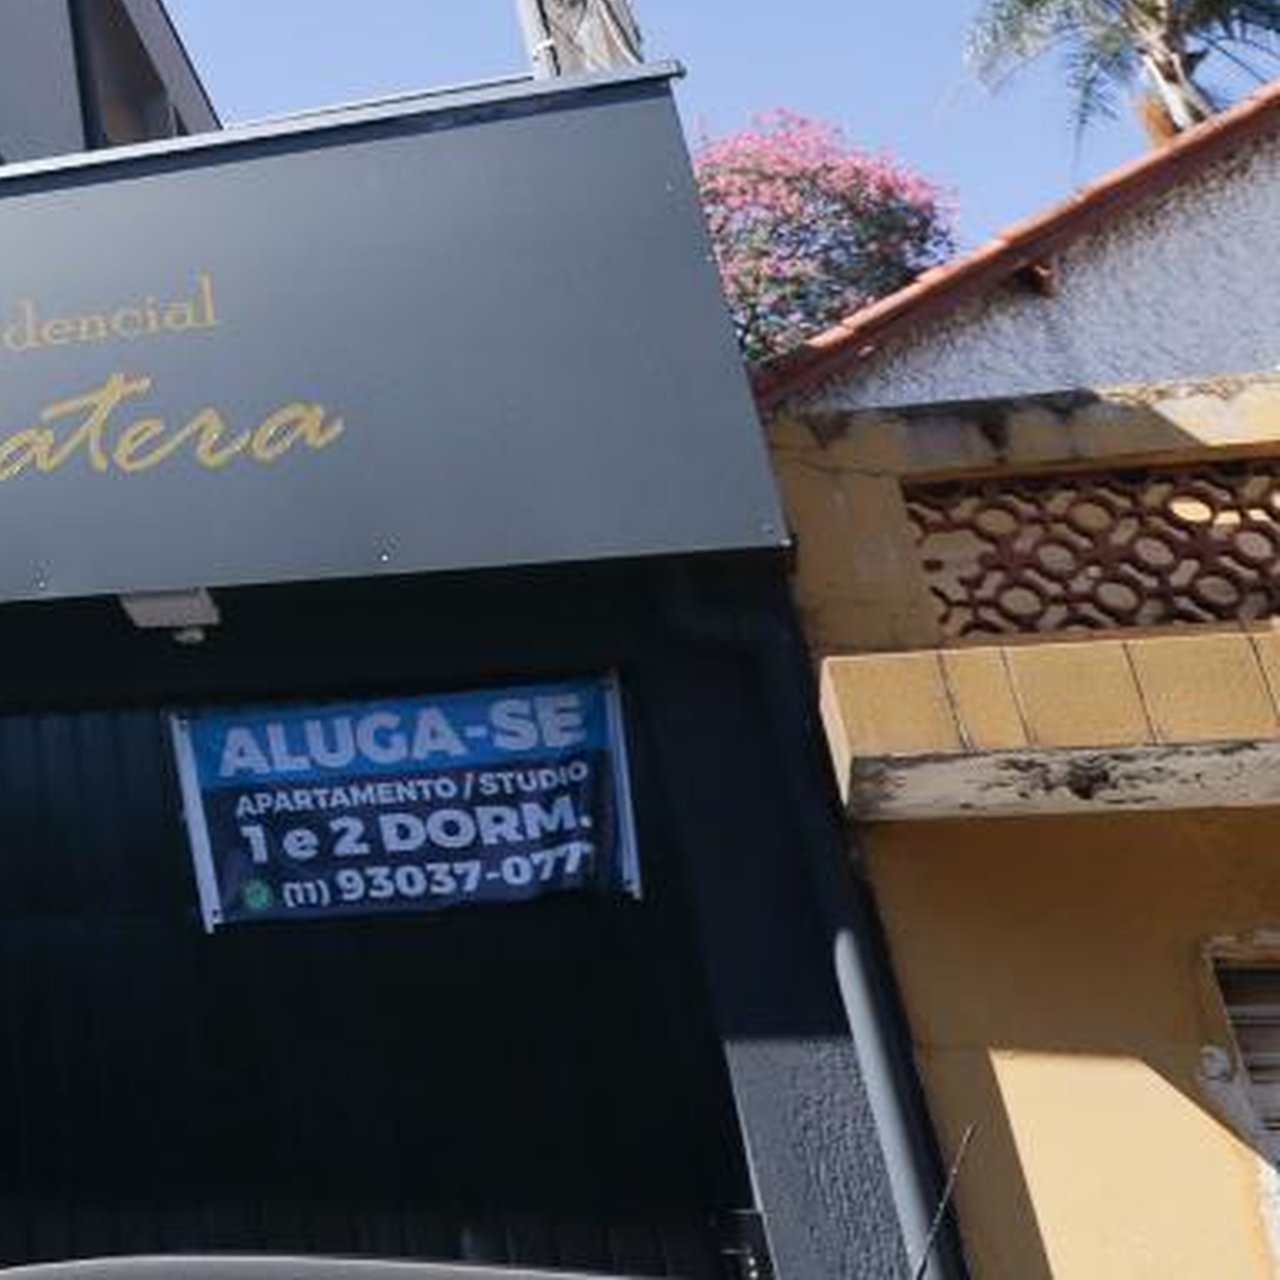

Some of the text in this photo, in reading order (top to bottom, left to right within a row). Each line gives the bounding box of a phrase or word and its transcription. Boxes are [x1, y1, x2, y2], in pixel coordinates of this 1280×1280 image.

[219, 694, 587, 778] ALUGA-SE
[236, 777, 458, 817] APARTAMENTO
[479, 761, 589, 795] STUDIO
[240, 795, 593, 863] 1 e 2 DORM.
[283, 841, 593, 908] (11) 93037-077
